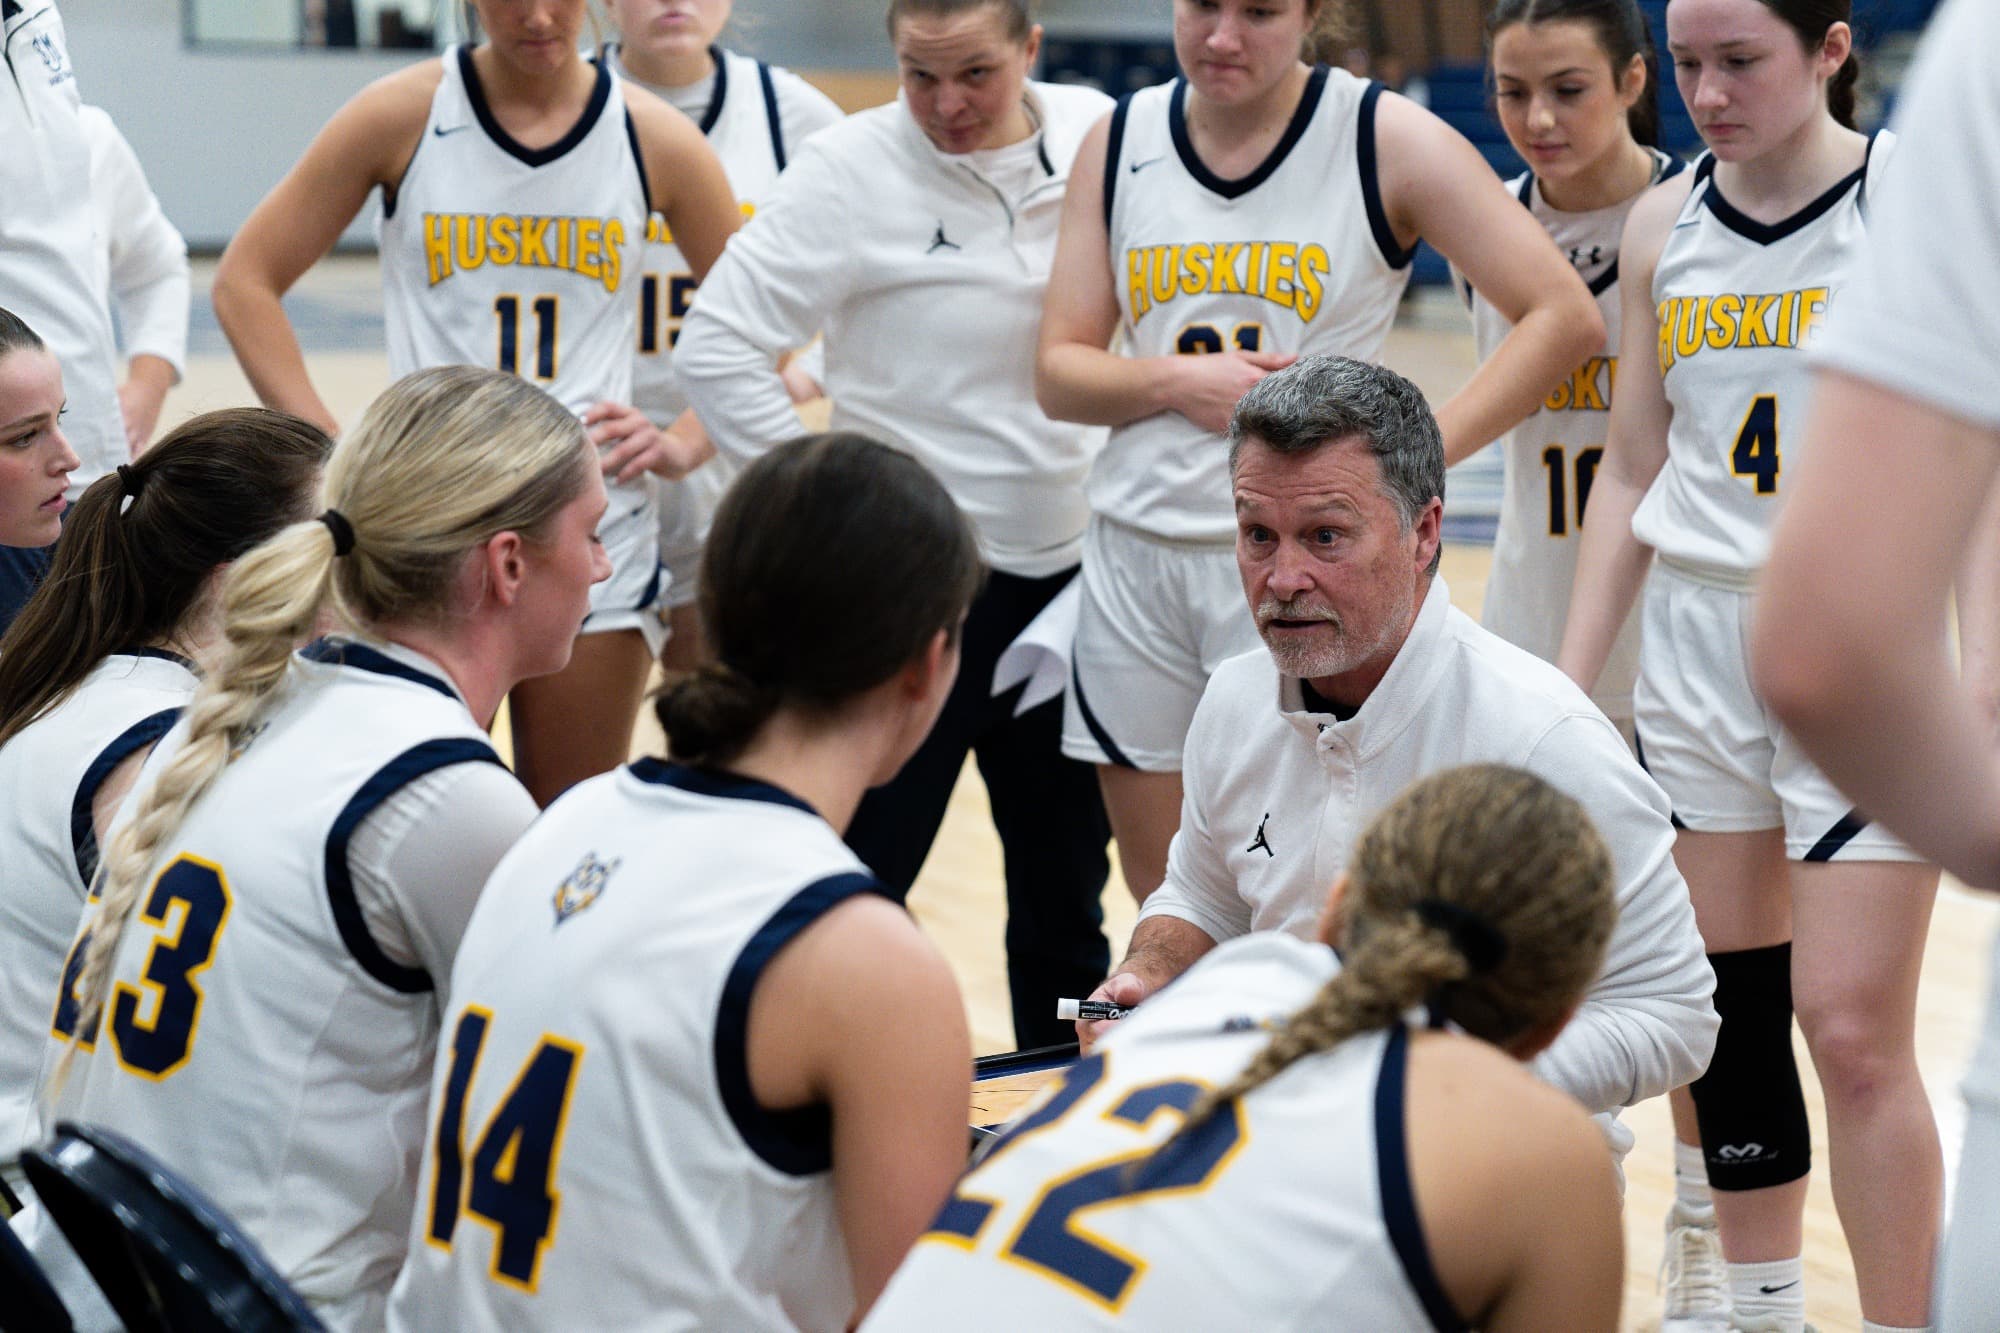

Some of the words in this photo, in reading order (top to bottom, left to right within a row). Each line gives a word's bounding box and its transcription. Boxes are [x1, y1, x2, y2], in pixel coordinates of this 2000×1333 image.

[423, 213, 625, 293] HUSKIES
[1127, 241, 1330, 324] HUSKIES
[494, 293, 559, 381] 11
[1658, 286, 1831, 378] HUSKIE
[1728, 393, 1782, 498] 4
[425, 1003, 584, 1294] 14
[918, 1050, 1250, 1315] 22
